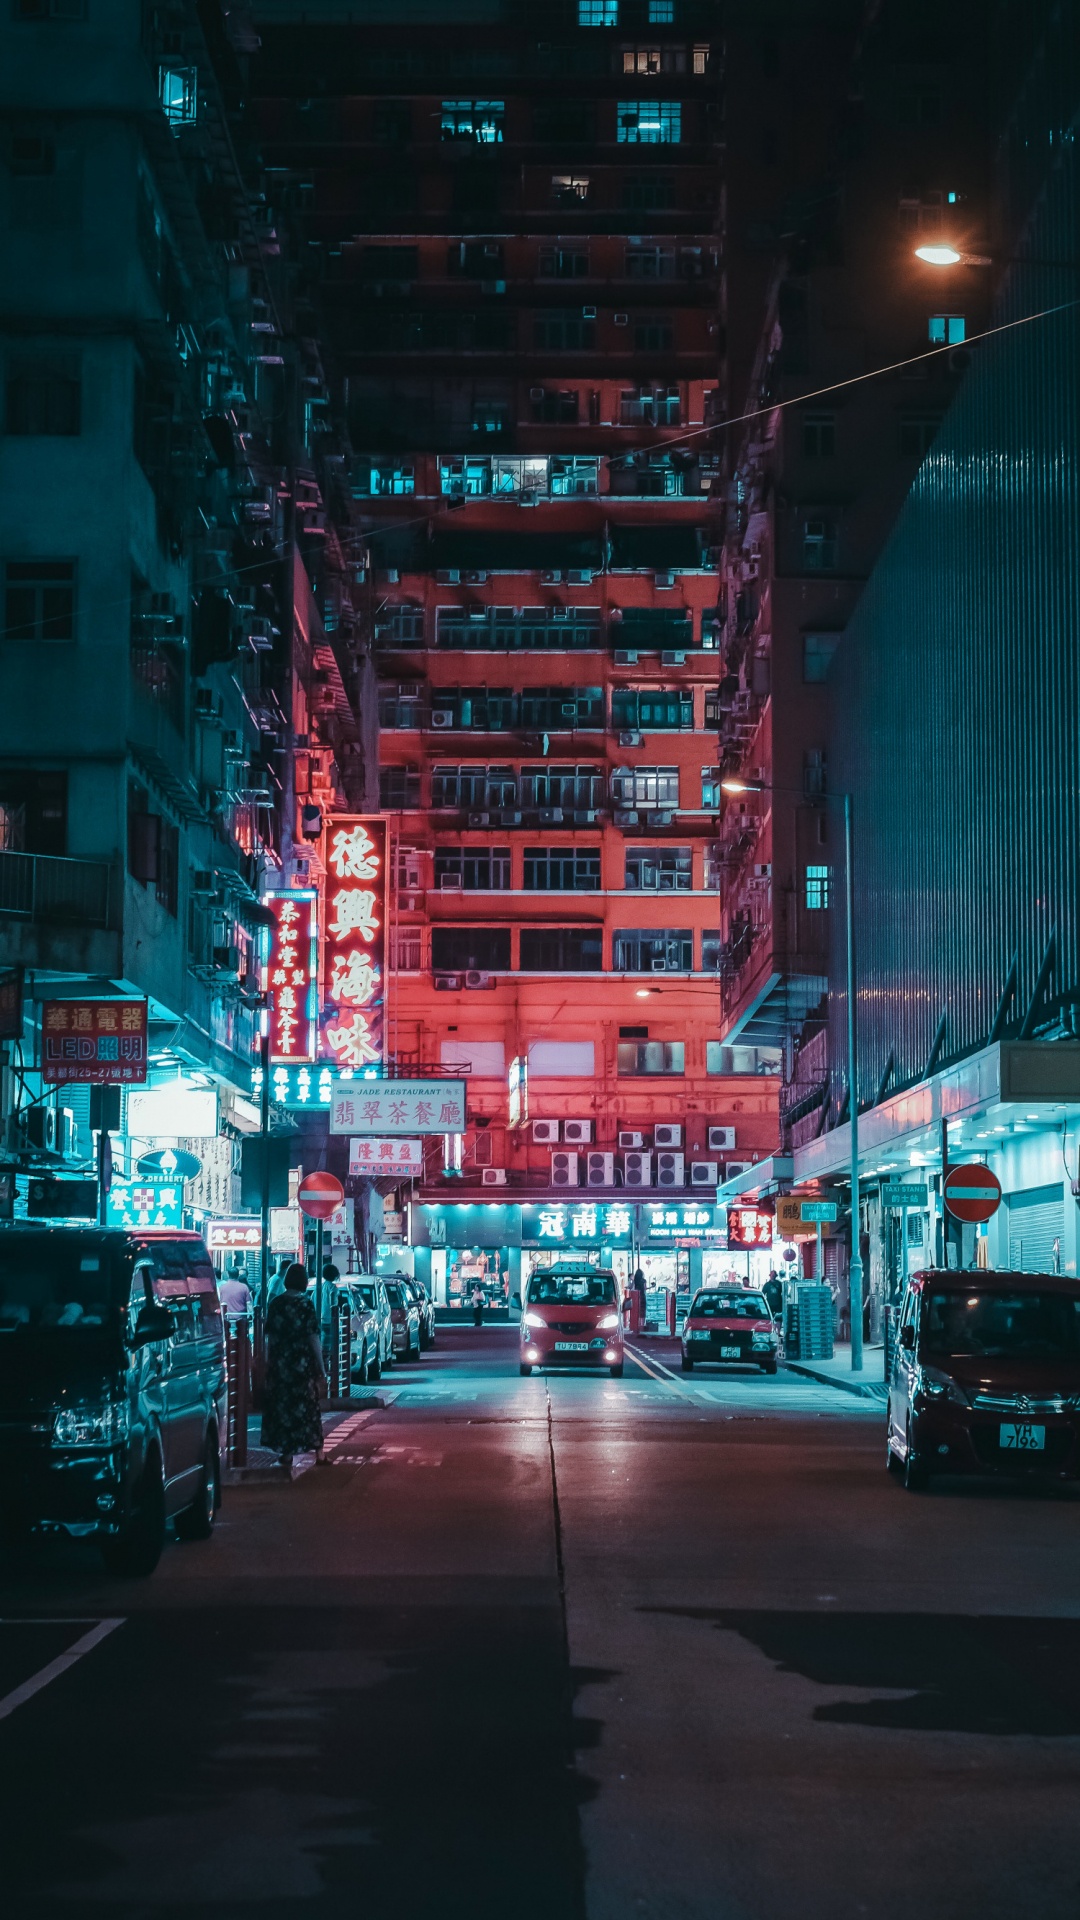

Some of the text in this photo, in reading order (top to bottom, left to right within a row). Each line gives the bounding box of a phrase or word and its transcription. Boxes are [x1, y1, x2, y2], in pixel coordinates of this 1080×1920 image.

[327, 826, 380, 1068] 德興海味
[46, 1007, 143, 1031] 華通電器
[46, 1035, 143, 1061] LED照明
[356, 1088, 381, 1096] JADE
[384, 1088, 441, 1096] RESTAURANT
[334, 1100, 463, 1127] 翡翠茶餐廳
[891, 1195, 919, 1203] 的士站
[538, 1210, 631, 1237] 冠南華
[1007, 1435, 1039, 1449] 7196
